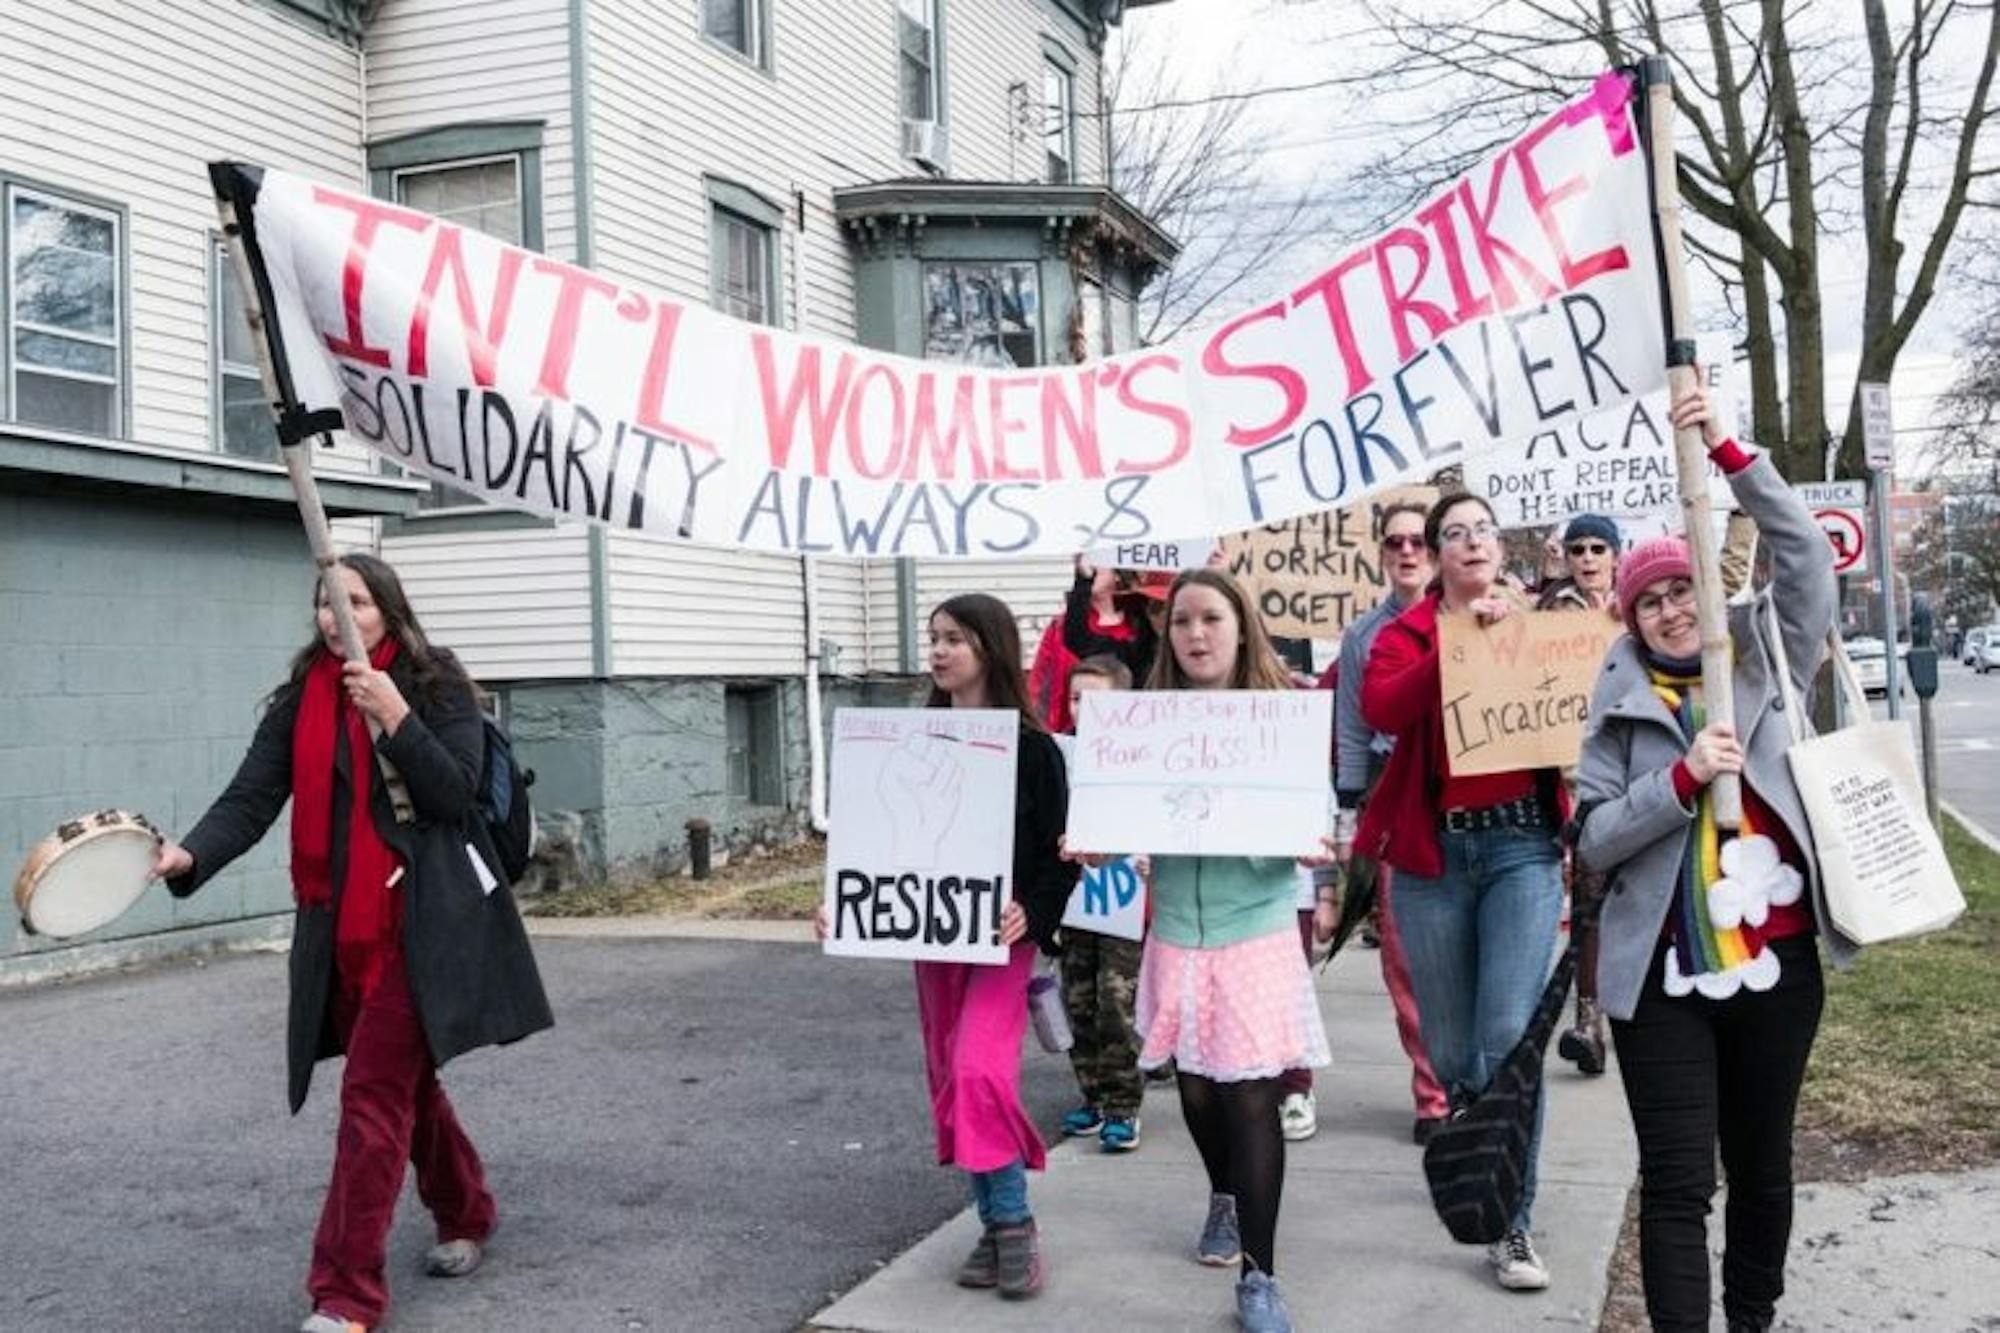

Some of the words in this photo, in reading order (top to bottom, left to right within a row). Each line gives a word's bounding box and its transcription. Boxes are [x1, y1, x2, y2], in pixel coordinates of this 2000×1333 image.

[312, 185, 723, 456] INT'L
[751, 333, 1192, 482] WOMEN'S
[1201, 98, 1630, 448] STRIKE
[341, 364, 725, 538] SOLIDARITY
[737, 470, 1039, 555] ALWAYS
[1240, 293, 1629, 522] FOREVER
[1526, 400, 1663, 460] ACA
[1576, 455, 1674, 487] REPEAL
[1804, 486, 1854, 502] TRUCK
[1520, 490, 1614, 521] HEALTH
[1623, 484, 1680, 509] CAR
[835, 869, 1004, 946] RESIST!
